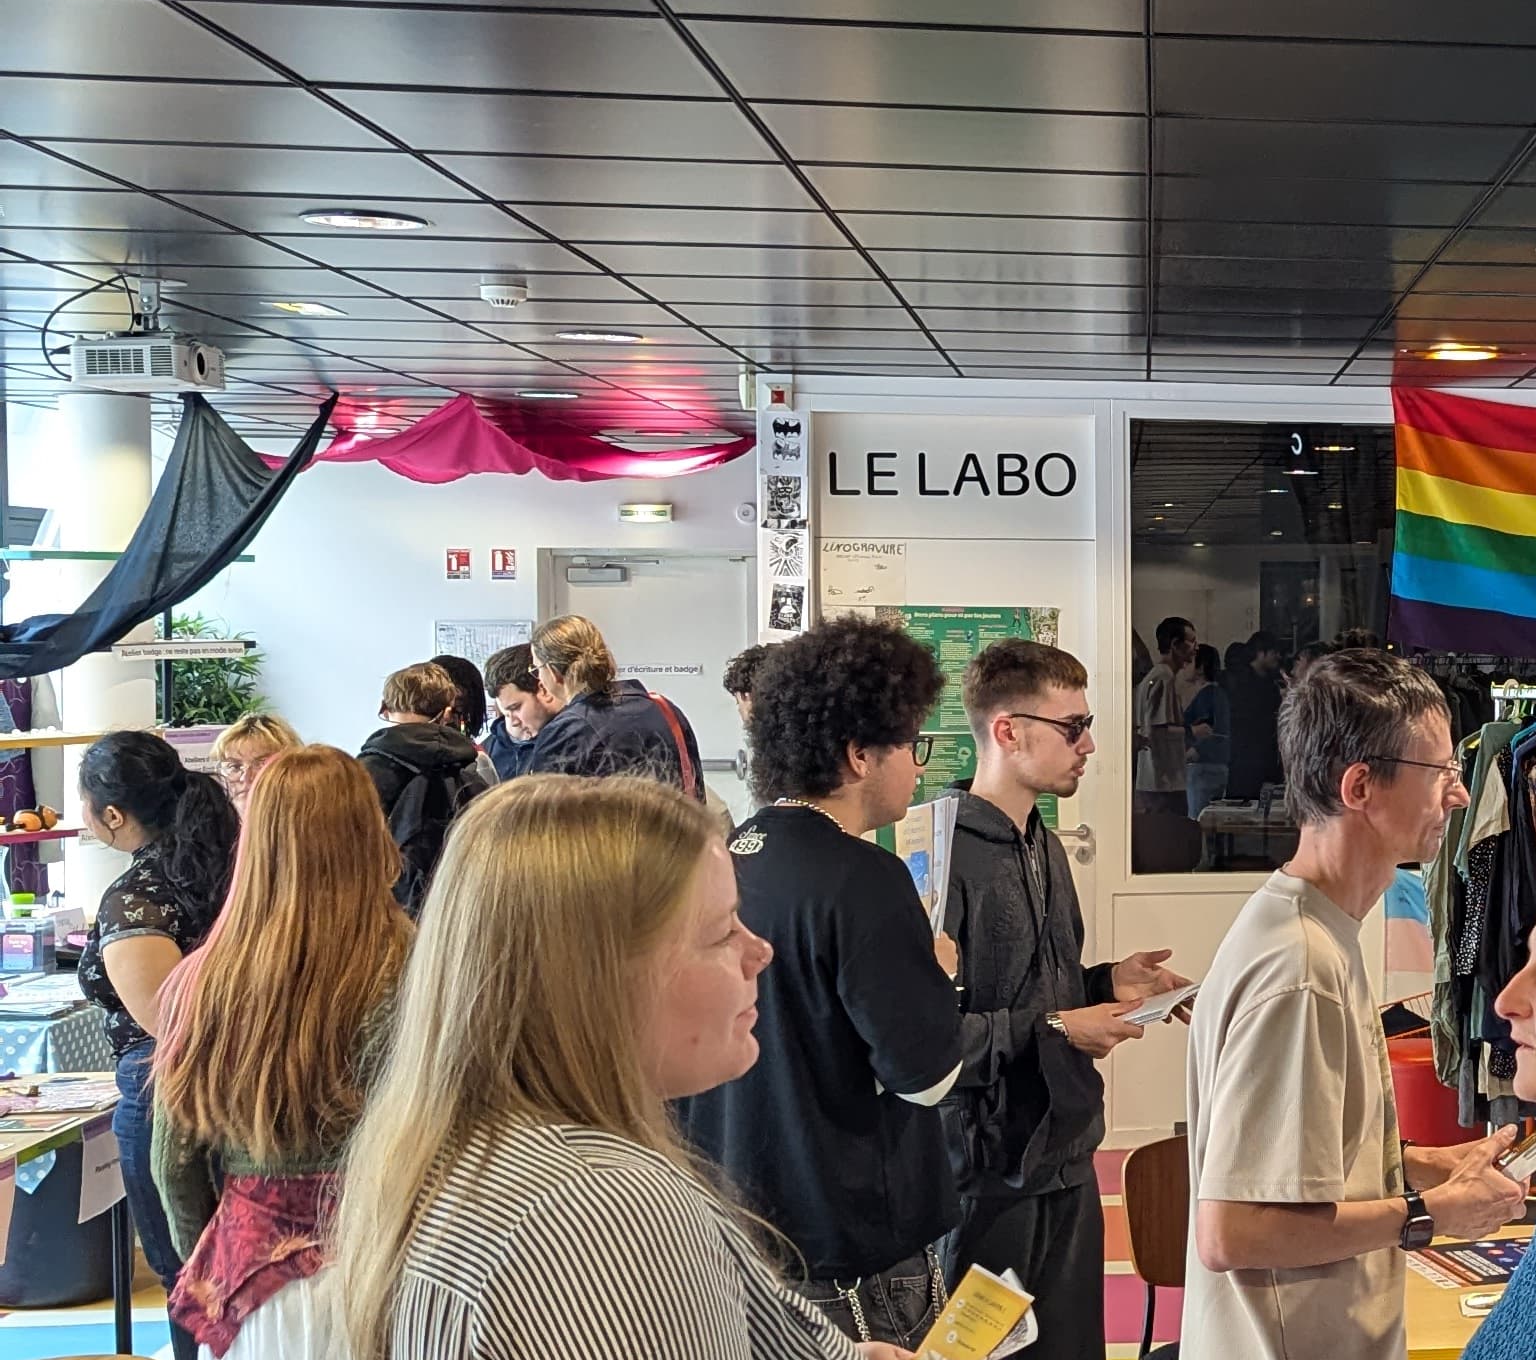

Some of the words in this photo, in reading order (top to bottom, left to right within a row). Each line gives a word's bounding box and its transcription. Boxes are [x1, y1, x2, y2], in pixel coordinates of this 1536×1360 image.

[828, 451, 899, 497] LE
[917, 451, 1078, 498] LABO
[822, 542, 905, 556] LINOGRAVURE
[673, 665, 699, 674] badge
